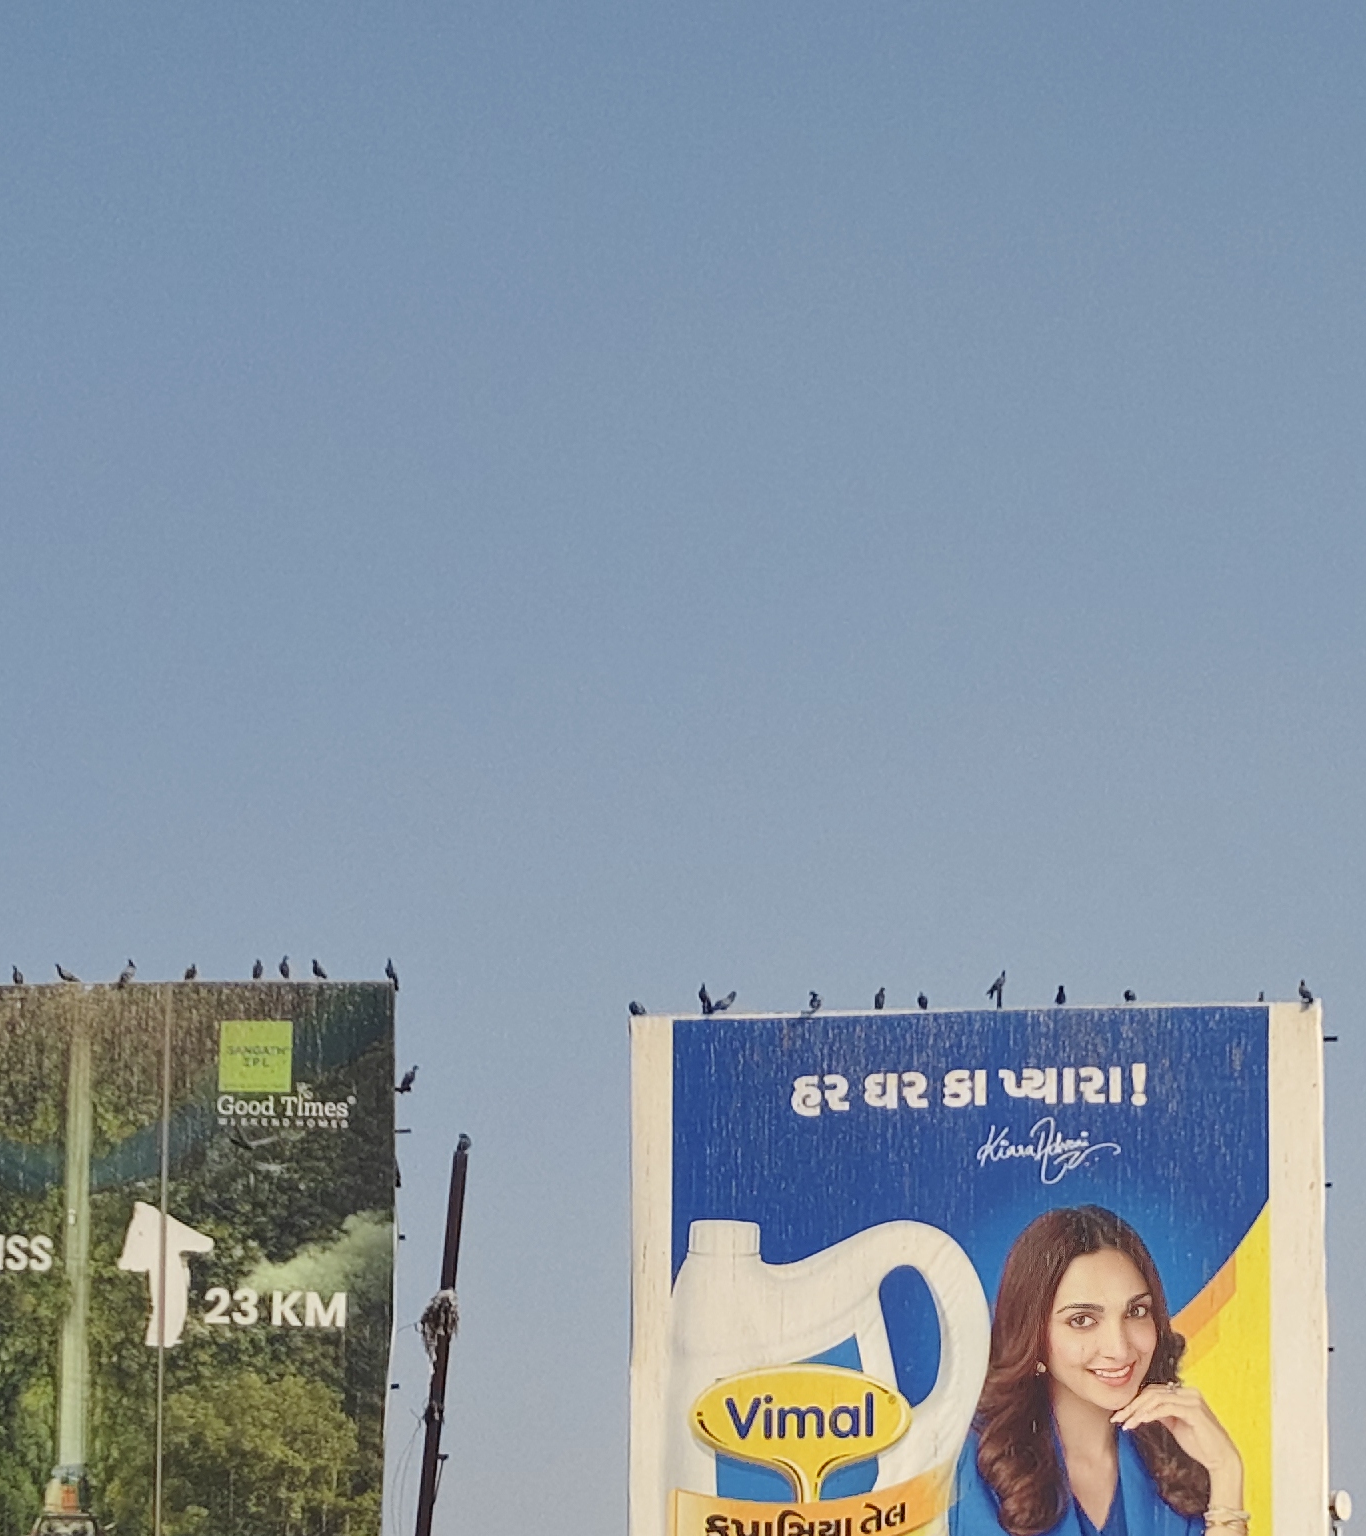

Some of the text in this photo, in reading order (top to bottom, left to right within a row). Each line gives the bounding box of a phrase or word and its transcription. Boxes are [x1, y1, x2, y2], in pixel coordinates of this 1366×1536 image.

[216, 1094, 350, 1117] Good Times
[791, 1074, 850, 1117] હર
[864, 1071, 930, 1110] ઘર
[942, 1069, 987, 1107] કા
[203, 1287, 347, 1328] 23 KM
[724, 1394, 875, 1440] Vimal
